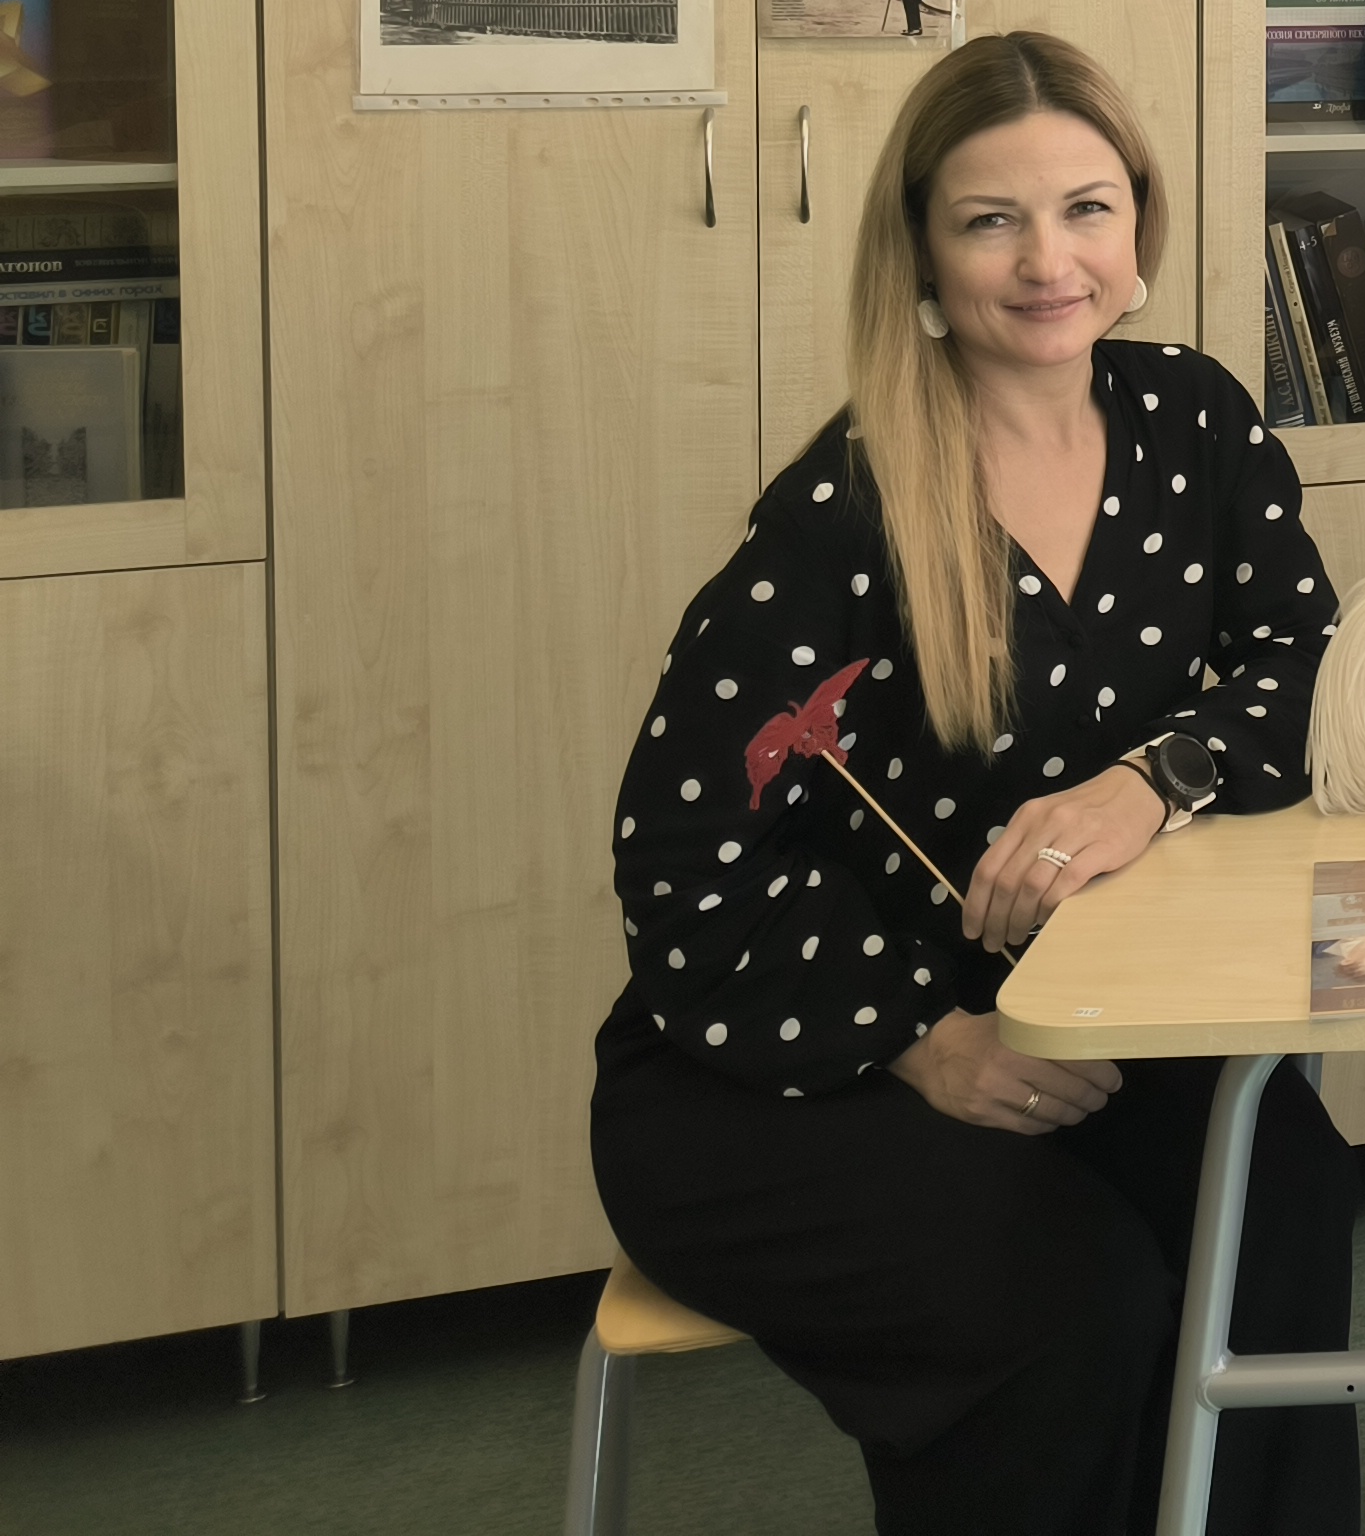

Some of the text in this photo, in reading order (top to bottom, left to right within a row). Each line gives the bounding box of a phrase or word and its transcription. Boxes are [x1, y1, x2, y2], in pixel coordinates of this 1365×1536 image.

[1294, 29, 1347, 40] СЕРЕБРЯНОГО
[1326, 318, 1364, 415] ПУШКИНСКИЙ МУЗЕУМ
